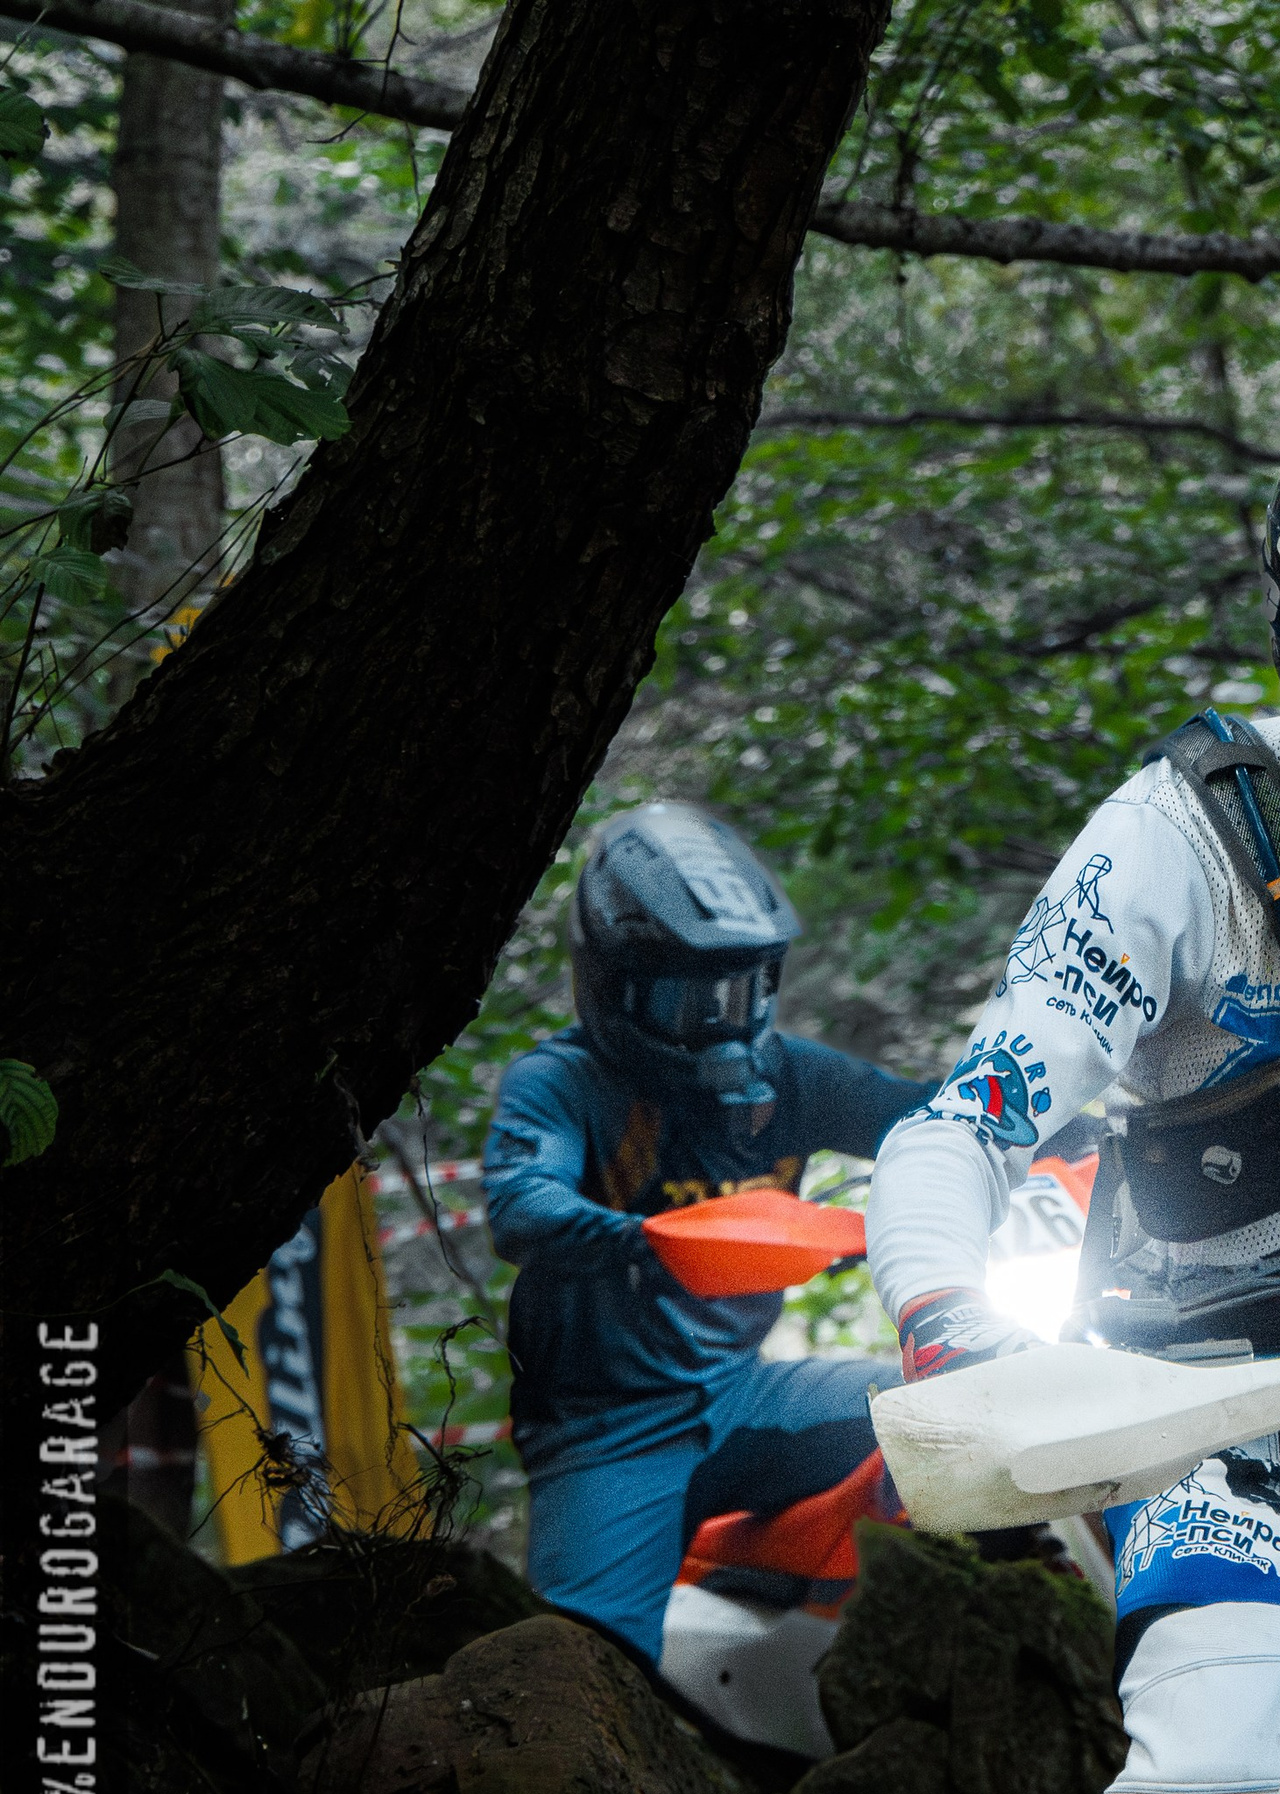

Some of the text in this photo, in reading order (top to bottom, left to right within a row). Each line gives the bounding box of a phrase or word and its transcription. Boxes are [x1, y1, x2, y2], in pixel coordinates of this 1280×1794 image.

[1062, 917, 1157, 1023] Нейро
[1045, 996, 1077, 1016] сеть
[1175, 1545, 1209, 1557] сеть
